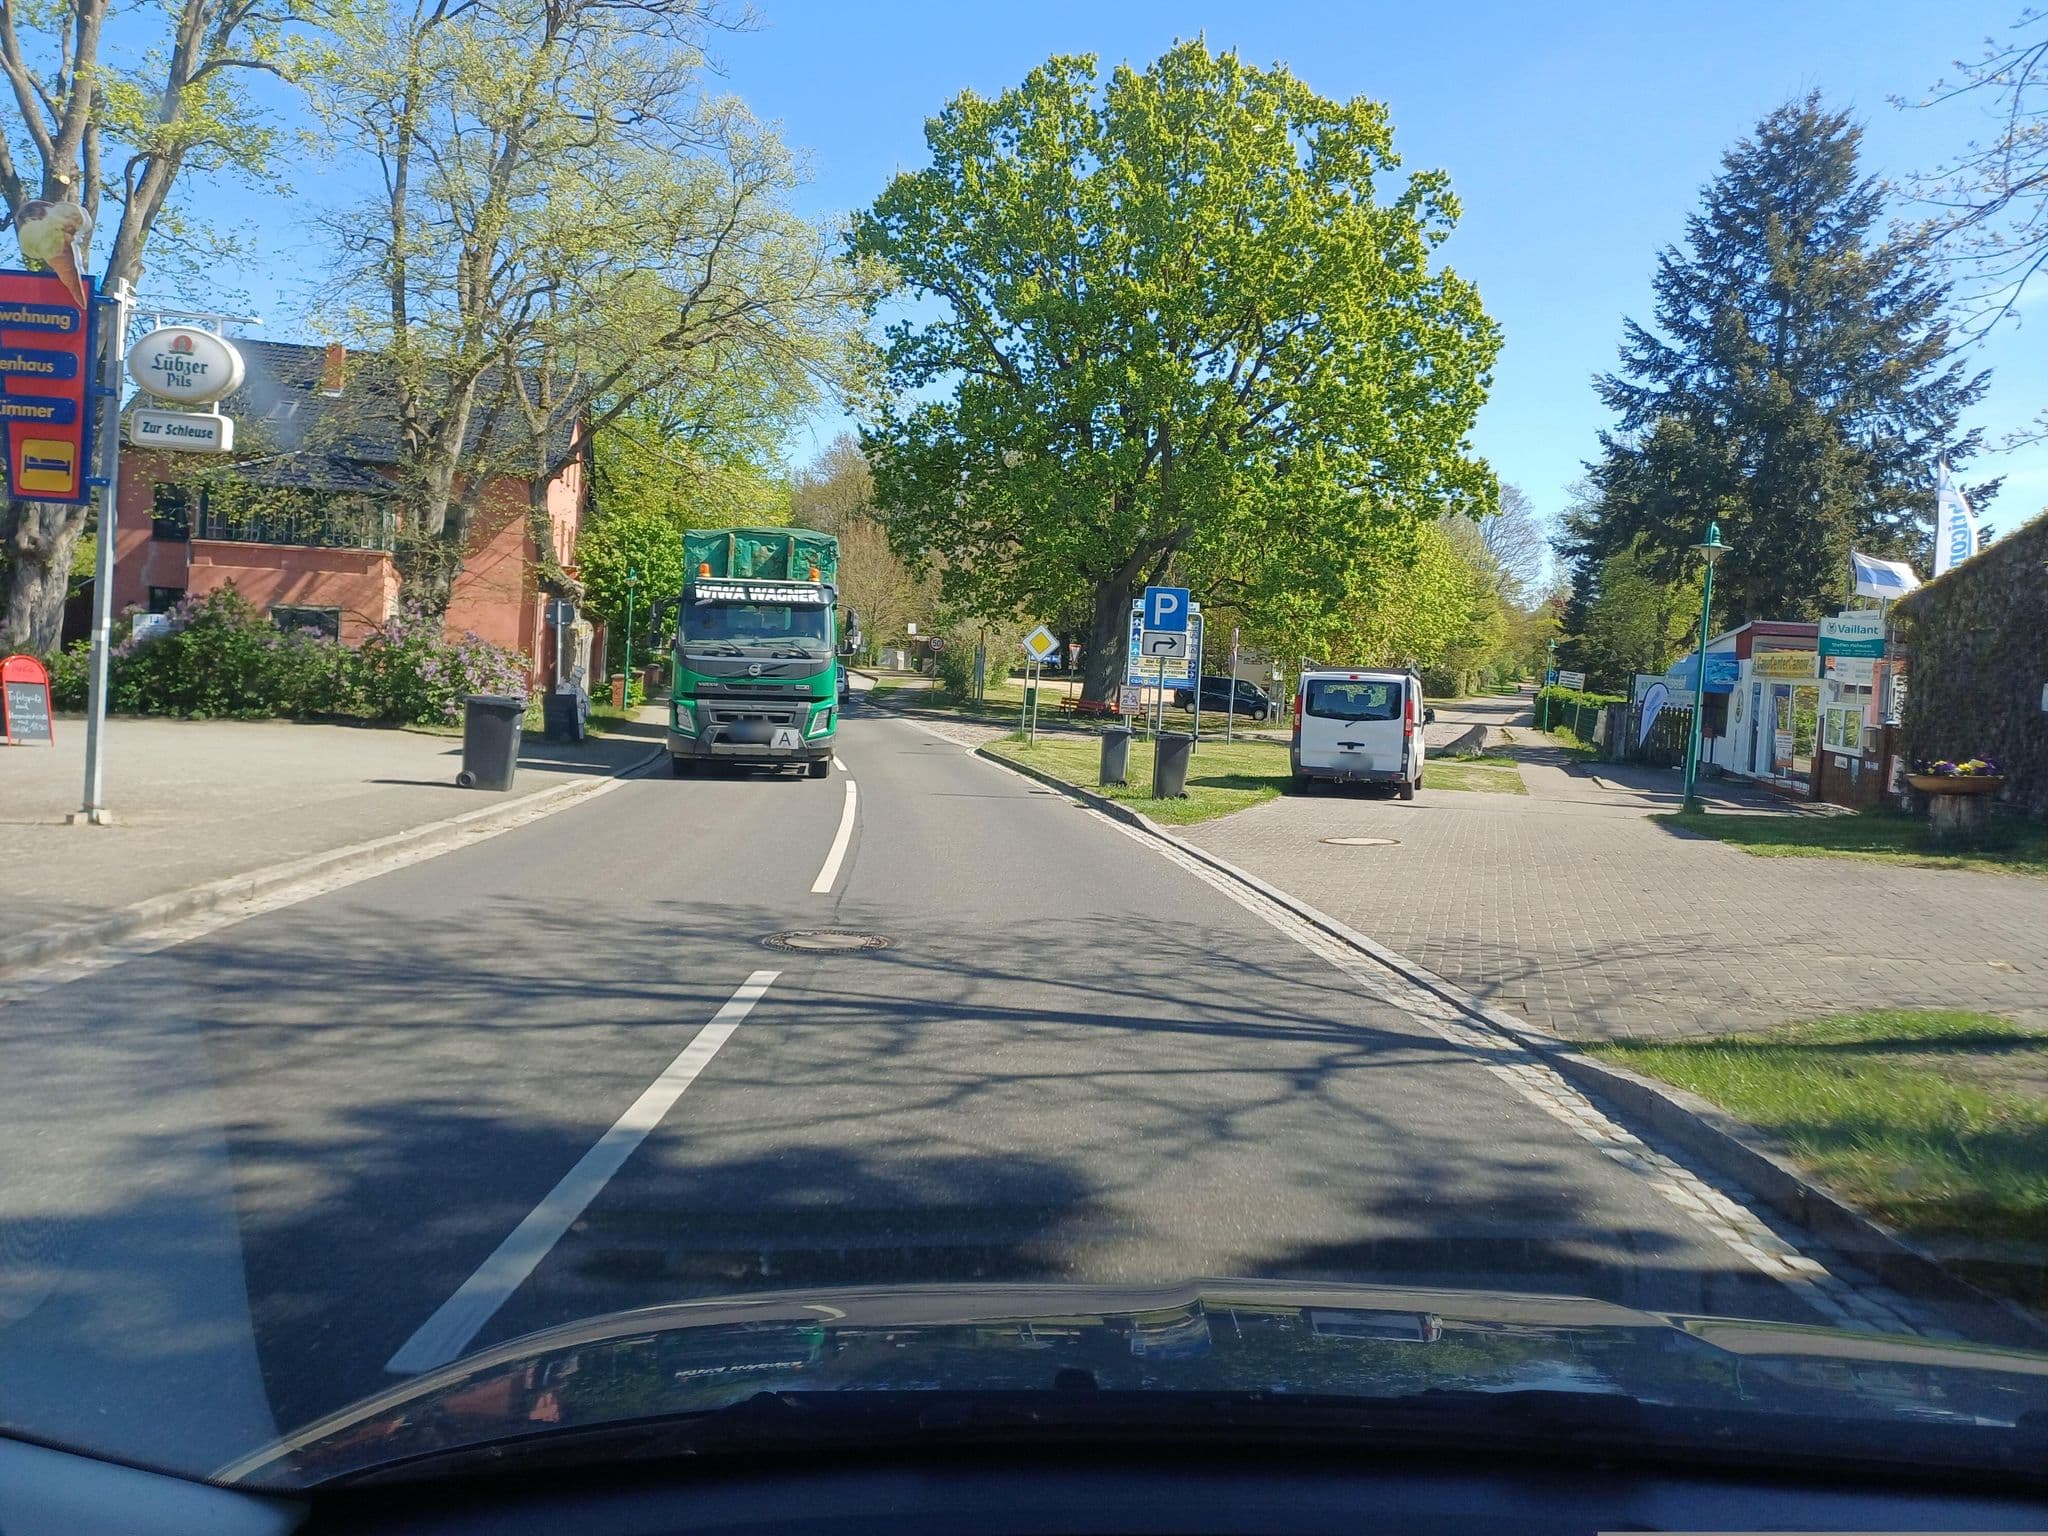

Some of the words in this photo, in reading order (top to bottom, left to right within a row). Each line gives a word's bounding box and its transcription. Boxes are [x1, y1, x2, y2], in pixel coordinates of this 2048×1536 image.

[152, 353, 208, 375] Lübzer
[167, 372, 192, 387] Pils
[0, 399, 55, 418] immer
[142, 421, 162, 434] Zur
[165, 424, 214, 439] Schleuse
[694, 583, 746, 600] WIWA
[748, 587, 820, 602] WAGNER
[1154, 593, 1179, 626] P
[1837, 624, 1880, 635] Vaillant
[778, 732, 791, 746] A
